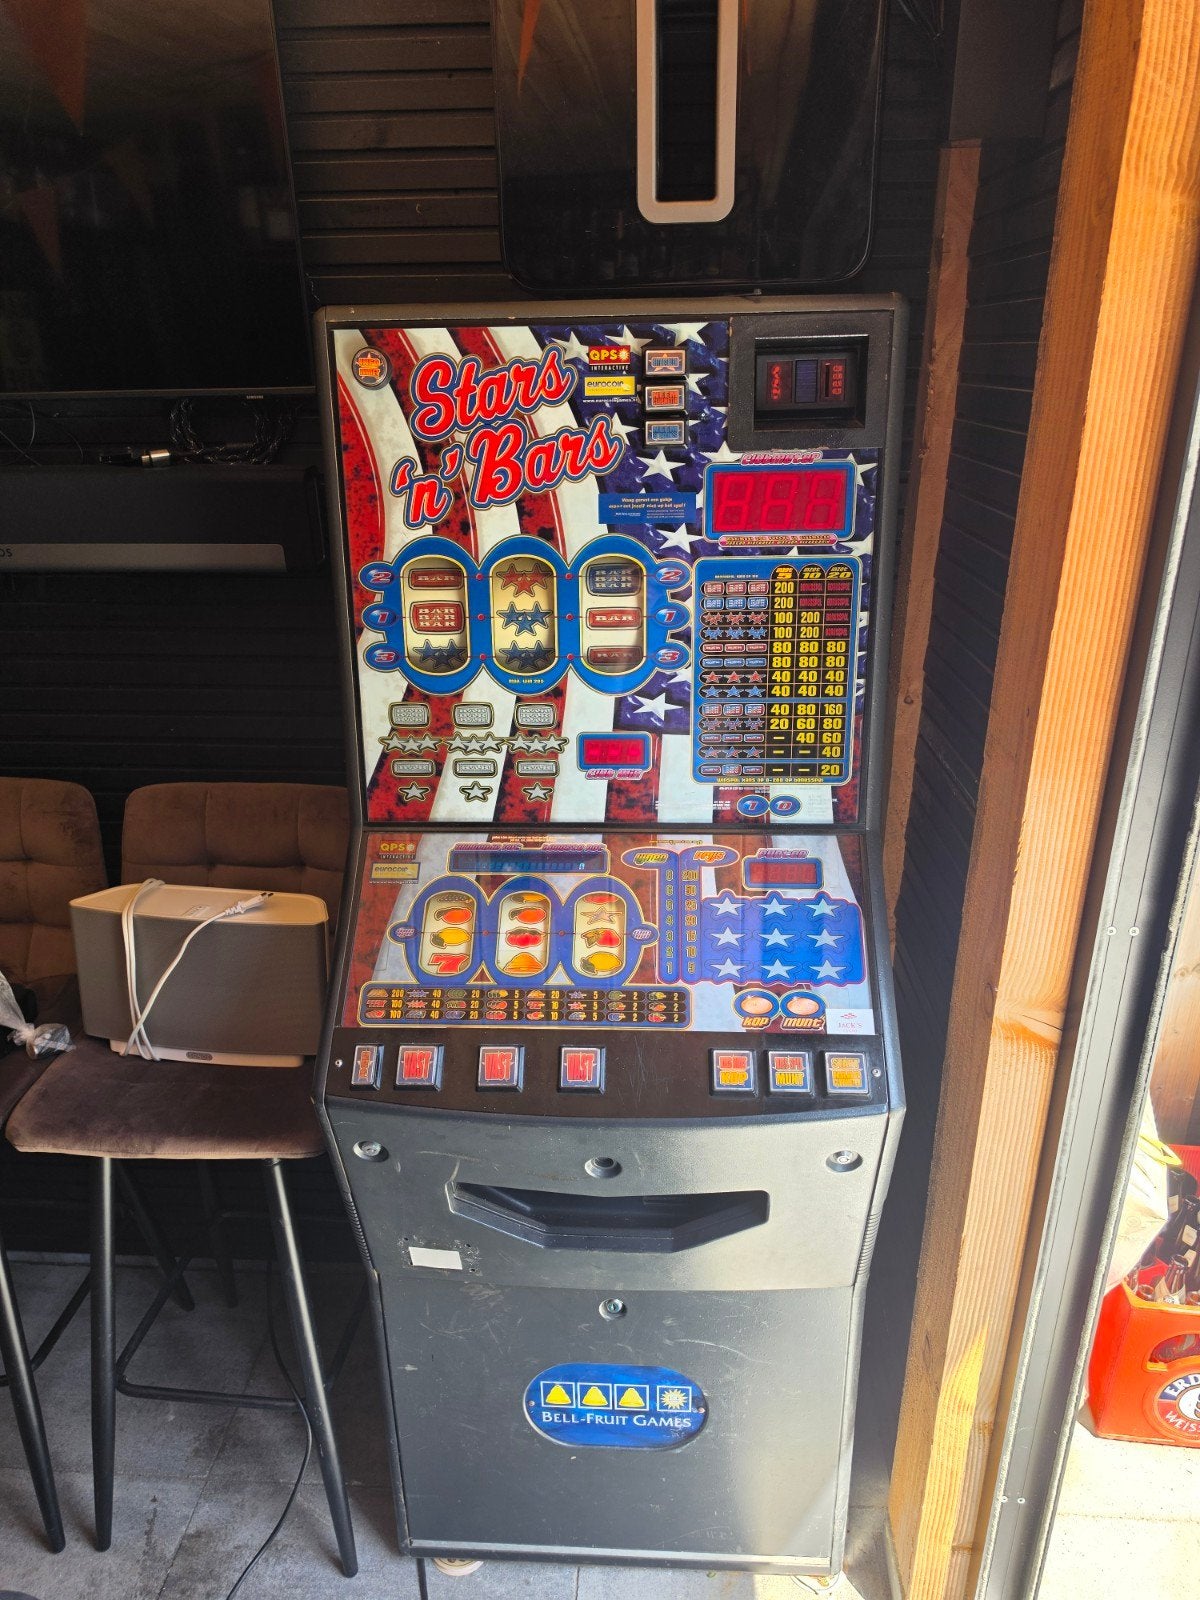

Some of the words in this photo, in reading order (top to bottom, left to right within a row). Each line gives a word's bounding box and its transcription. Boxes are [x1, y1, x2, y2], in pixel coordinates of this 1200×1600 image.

[589, 349, 618, 361] QPS
[413, 350, 572, 437] Stars
[470, 420, 620, 504] Bars
[369, 571, 392, 582] 2
[659, 570, 681, 582] 2
[774, 581, 794, 594] 200
[774, 597, 793, 609] 200
[377, 612, 388, 623] 1
[663, 611, 676, 622] 1
[774, 612, 793, 624] 100
[801, 612, 820, 623] 200
[774, 627, 792, 639] 100
[800, 626, 819, 638] 200
[773, 642, 792, 654] 80
[800, 642, 819, 653] 80
[826, 641, 846, 653] 80
[374, 652, 395, 662] 3
[660, 650, 681, 661] 3
[772, 656, 791, 668] 80
[799, 656, 818, 668] 80
[826, 656, 845, 667] 80
[772, 671, 791, 683] 40
[798, 671, 818, 682] 40
[825, 670, 844, 682] 40
[771, 685, 790, 697] 40
[798, 685, 817, 697] 40
[824, 685, 844, 696] 40
[770, 704, 790, 715] 40
[797, 704, 816, 715] 80
[824, 703, 842, 715] 160
[770, 718, 789, 730] 20
[797, 718, 815, 730] 60
[823, 718, 842, 730] 80
[796, 733, 815, 744] 40
[822, 733, 841, 744] 60
[822, 746, 841, 757] 40
[821, 765, 840, 775] 20
[380, 843, 406, 851] QPS
[391, 990, 404, 998] 200
[432, 990, 442, 998] 40
[471, 990, 480, 998] 20
[514, 990, 519, 998] 5
[593, 991, 598, 999] 5
[633, 992, 638, 1000] 2
[674, 992, 679, 1000] 2
[391, 1000, 403, 1008] 100
[432, 1000, 440, 1008] 40
[514, 1001, 519, 1009] 5
[593, 1002, 598, 1010] 5
[633, 1002, 638, 1010] 2
[674, 1003, 679, 1011] 2
[430, 1011, 439, 1019] 40
[513, 1011, 518, 1019] 5
[593, 1013, 597, 1021] 5
[633, 1013, 638, 1021] 2
[674, 1013, 679, 1021] 2
[542, 1411, 628, 1426] BELL-FRUIT
[633, 1414, 692, 1427] GAMES
[1165, 1411, 1200, 1433] WEIS
